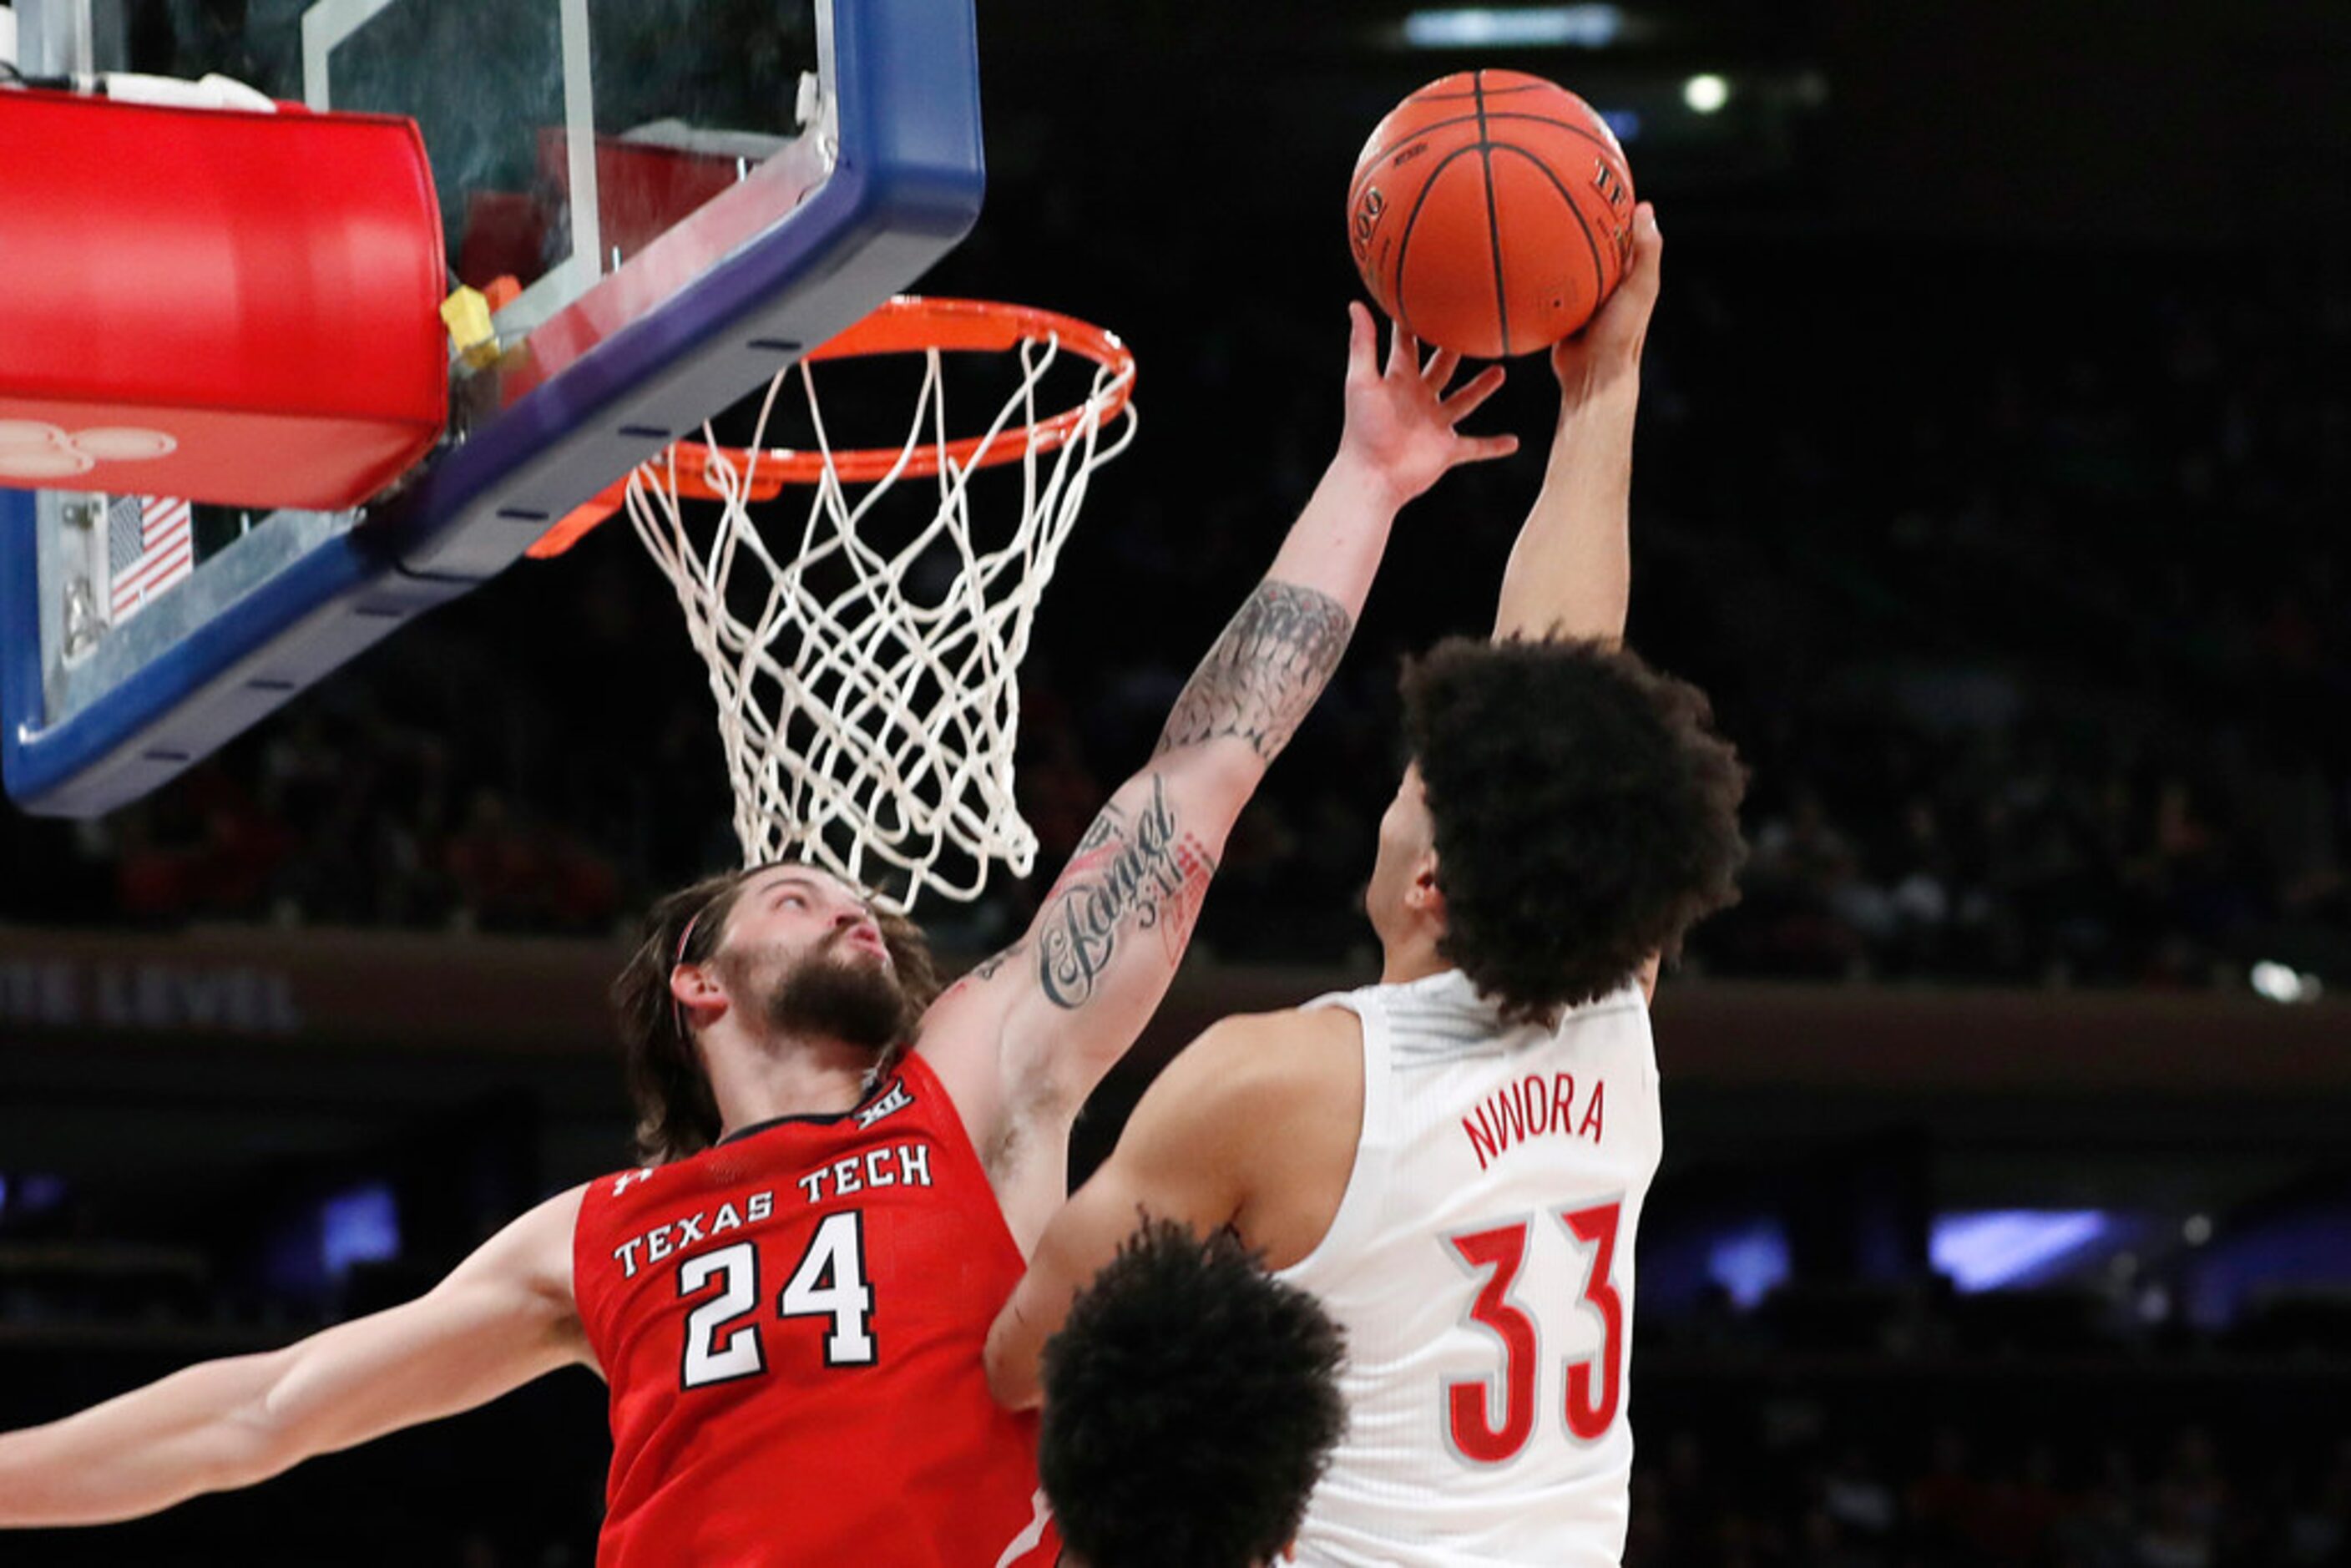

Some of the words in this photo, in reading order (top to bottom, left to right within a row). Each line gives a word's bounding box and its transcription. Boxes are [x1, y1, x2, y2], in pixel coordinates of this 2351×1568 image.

[1039, 772, 1175, 1009] Daniel
[96, 960, 302, 1034] LEVEL
[1461, 1072, 1605, 1171] NWORA
[613, 1190, 774, 1279] TEXAS
[797, 1144, 933, 1205] TECH
[677, 1208, 877, 1391] 24
[1437, 1191, 1625, 1471] 33
